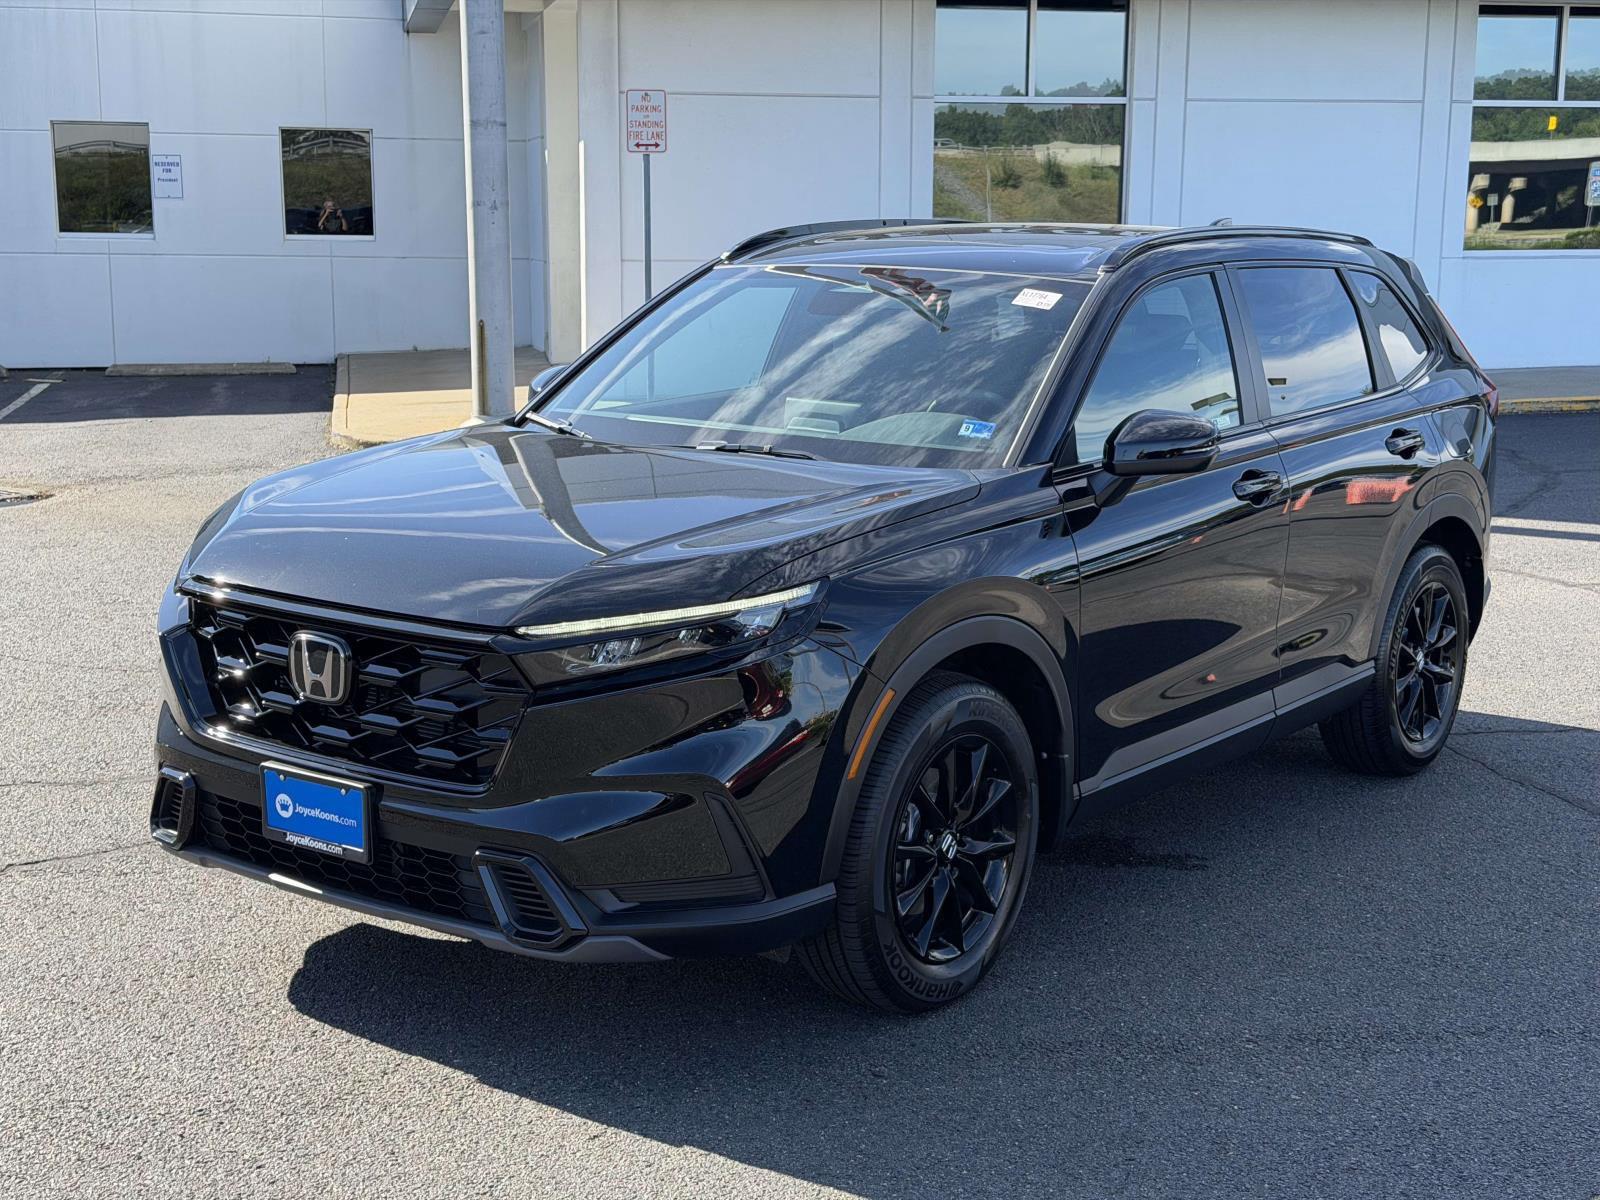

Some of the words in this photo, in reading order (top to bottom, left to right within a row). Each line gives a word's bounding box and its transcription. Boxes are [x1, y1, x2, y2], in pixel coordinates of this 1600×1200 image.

[641, 95, 651, 103] NO
[631, 104, 661, 113] PARKING
[629, 120, 664, 129] STANDING
[629, 130, 645, 141] FIRE
[646, 130, 665, 141] LANE
[295, 803, 357, 828] JoyceKoons.com
[285, 832, 343, 856] JoyceKoons.com
